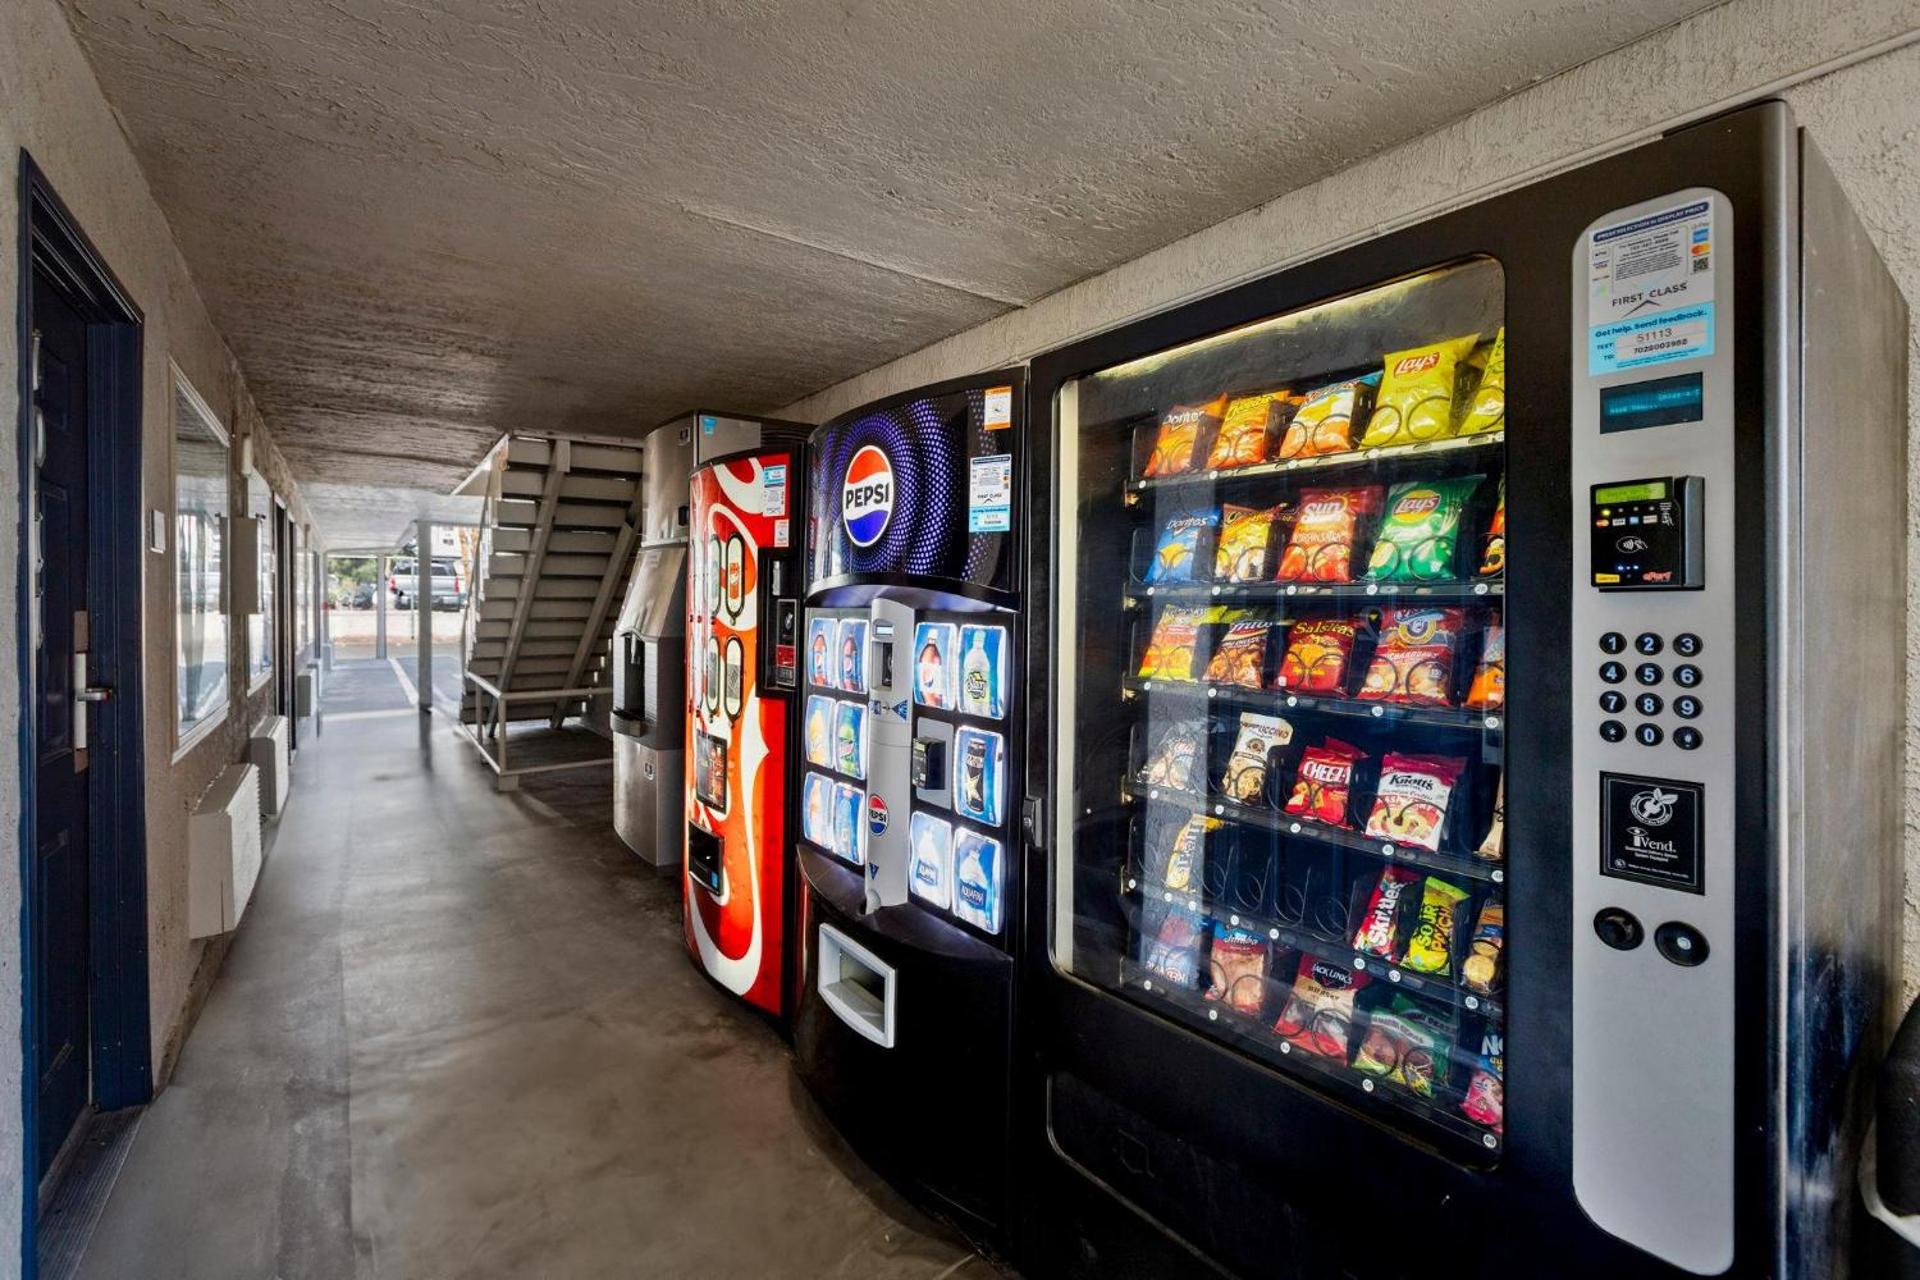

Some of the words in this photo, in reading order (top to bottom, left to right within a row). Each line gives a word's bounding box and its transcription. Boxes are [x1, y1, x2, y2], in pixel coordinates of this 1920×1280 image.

[1612, 292, 1643, 307] FIRST
[1649, 282, 1688, 298] CLASS
[846, 483, 889, 509] PEPSI
[1608, 636, 1616, 651] 1
[1643, 636, 1654, 651] 2
[1681, 638, 1694, 652] 3
[1606, 665, 1617, 680] 4
[1644, 667, 1655, 682] 5
[1681, 668, 1694, 684] 6
[1608, 695, 1617, 710] 7
[1644, 697, 1654, 712] 8
[1681, 700, 1694, 715] 9
[1644, 728, 1655, 743] 0
